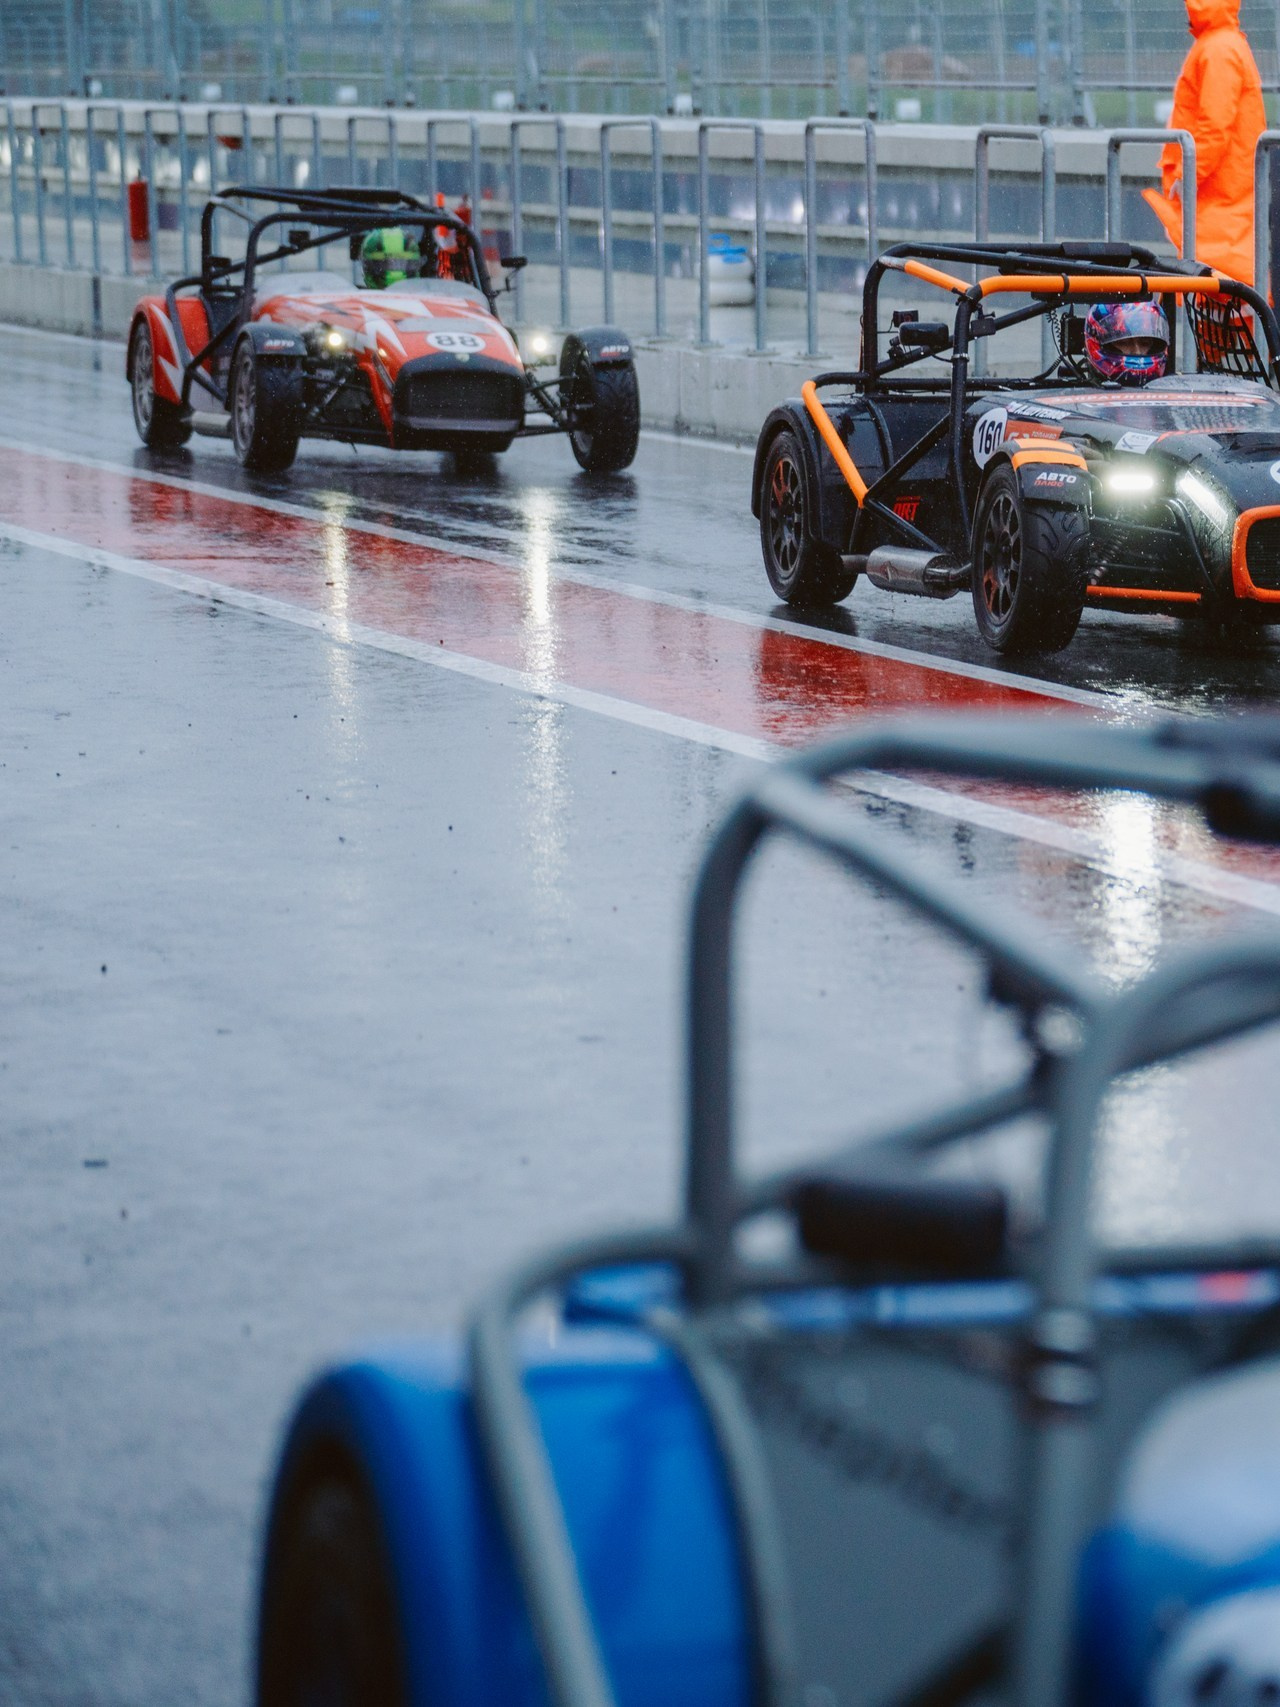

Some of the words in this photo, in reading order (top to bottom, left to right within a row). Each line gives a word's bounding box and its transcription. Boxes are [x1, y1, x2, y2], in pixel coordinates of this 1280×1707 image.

[434, 335, 479, 347] 88
[978, 420, 1003, 454] 160
[1036, 472, 1077, 484] АВТО
